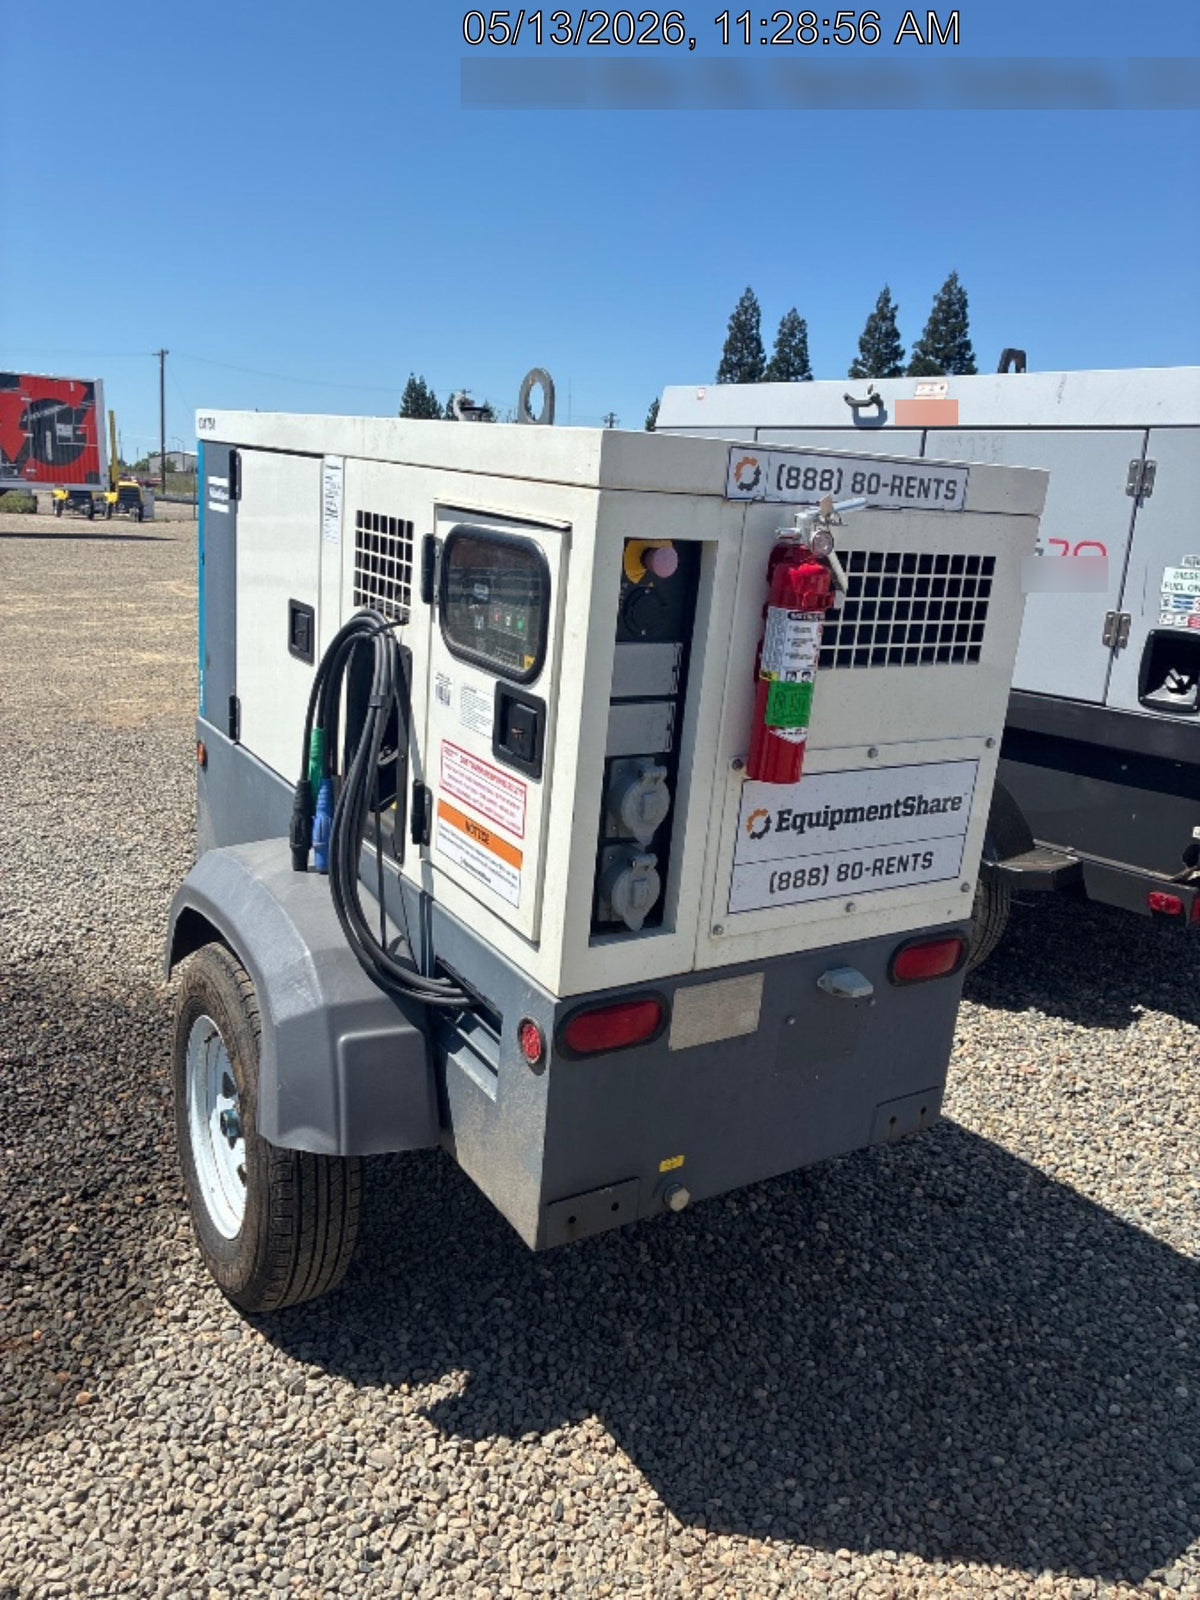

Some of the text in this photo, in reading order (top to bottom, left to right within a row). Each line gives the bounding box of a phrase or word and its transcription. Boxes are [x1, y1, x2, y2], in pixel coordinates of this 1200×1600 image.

[776, 463, 958, 500] (888) 80-RENTS
[775, 795, 963, 835] EquipmentShare
[769, 851, 934, 894] (888) 80-RENTS
